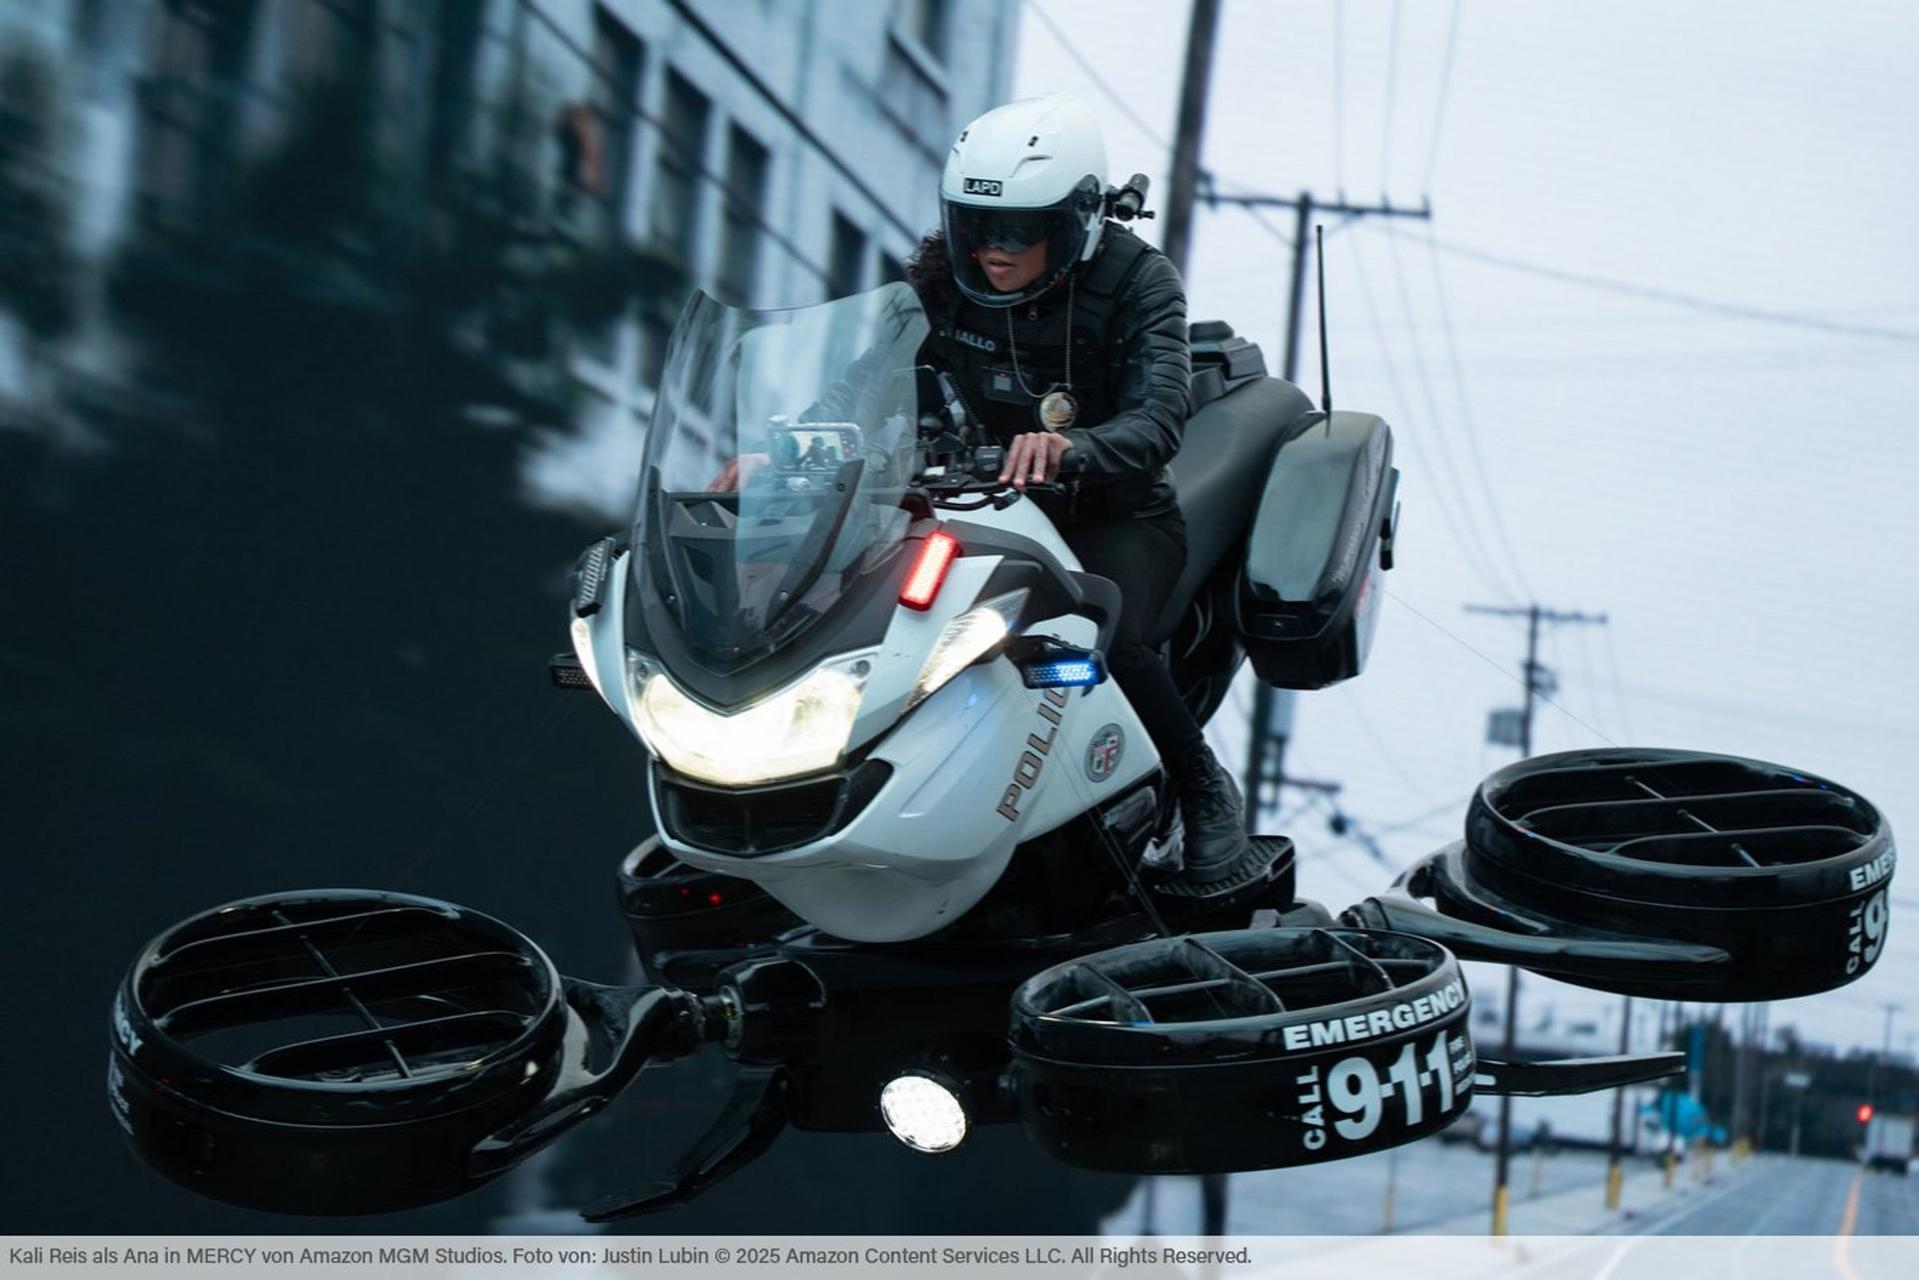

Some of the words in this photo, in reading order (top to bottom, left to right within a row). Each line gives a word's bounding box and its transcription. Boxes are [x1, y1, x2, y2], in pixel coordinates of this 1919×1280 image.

[964, 180, 1000, 194] LAPD
[996, 687, 1072, 822] POLIC
[1846, 899, 1866, 975] CALL
[1282, 977, 1466, 1051] EMERGENCY
[1296, 1064, 1327, 1151] CALL
[1327, 1030, 1453, 1141] 9-1-1
